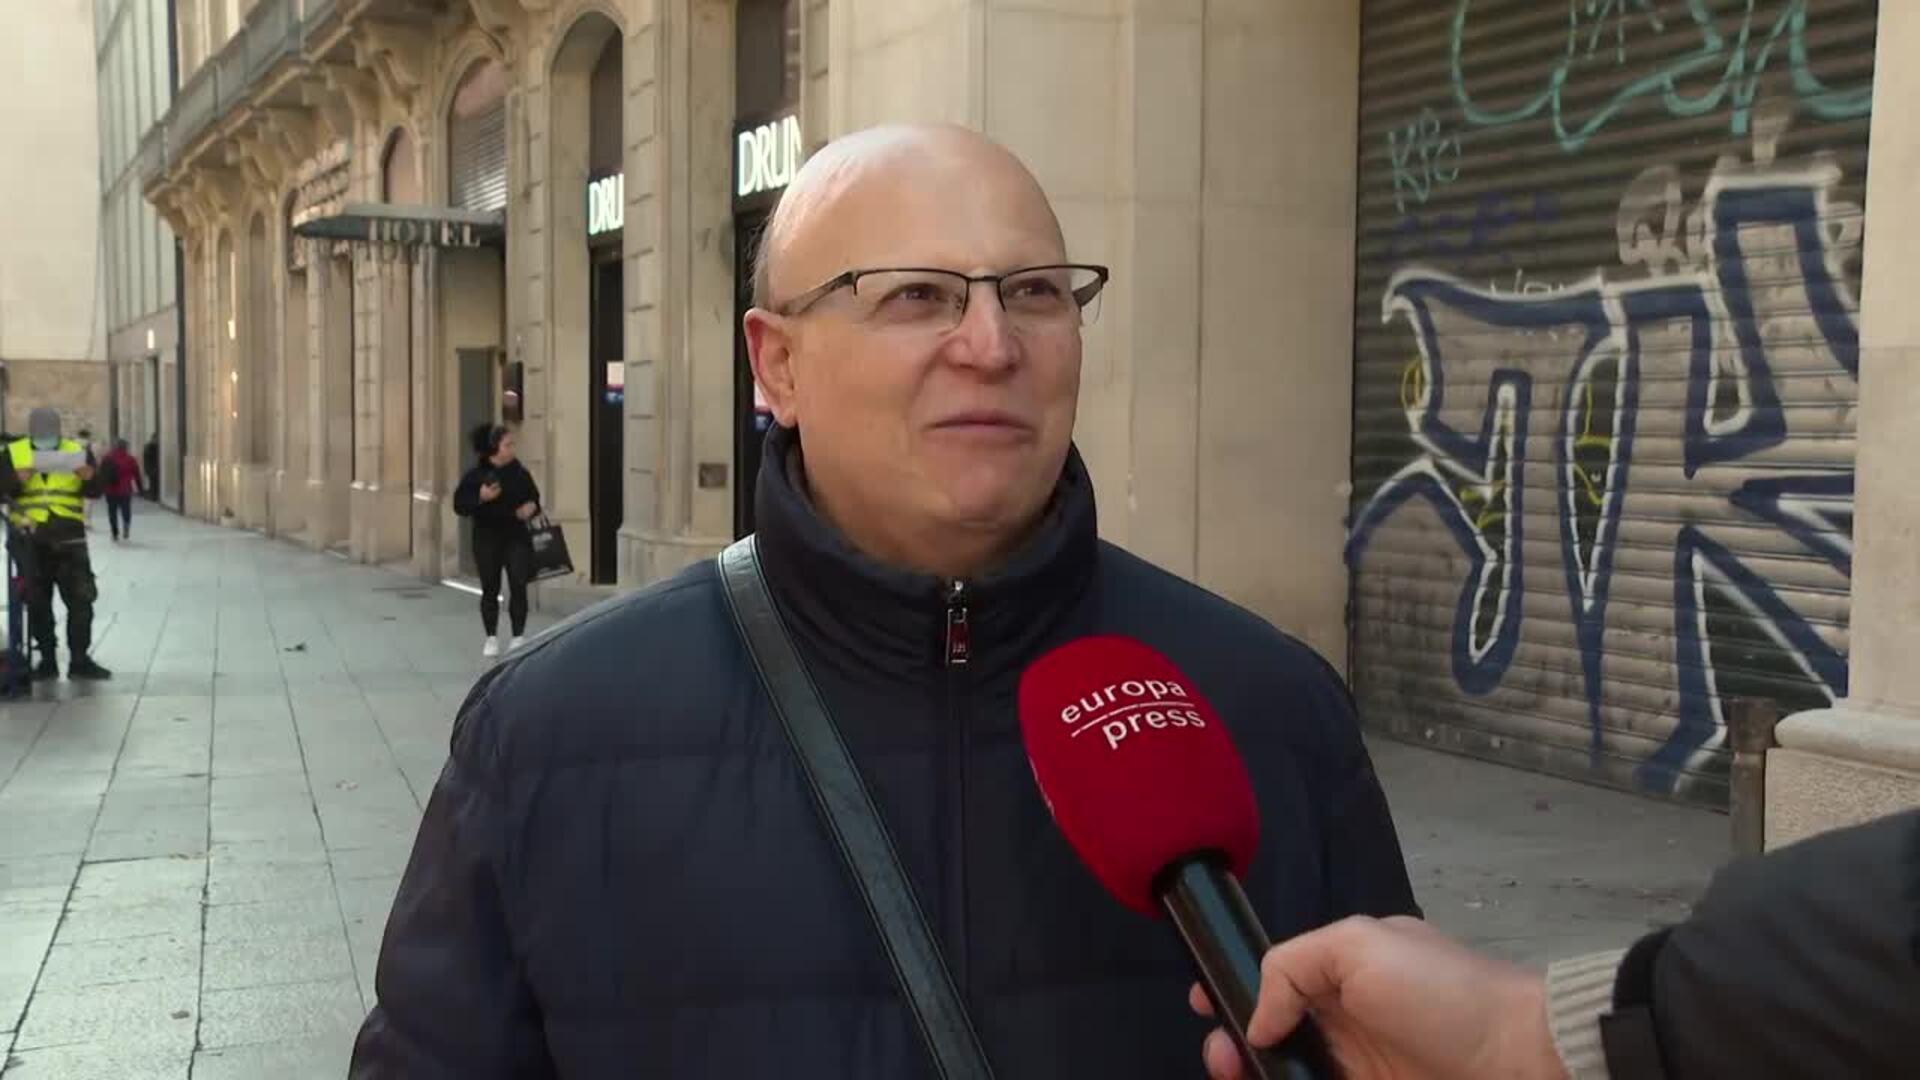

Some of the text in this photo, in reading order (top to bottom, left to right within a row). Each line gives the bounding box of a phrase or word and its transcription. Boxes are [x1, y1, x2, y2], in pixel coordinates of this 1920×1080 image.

[588, 173, 625, 236] DRU
[368, 216, 481, 247] HOTEL
[1060, 679, 1188, 724] europa
[1102, 708, 1206, 750] press
